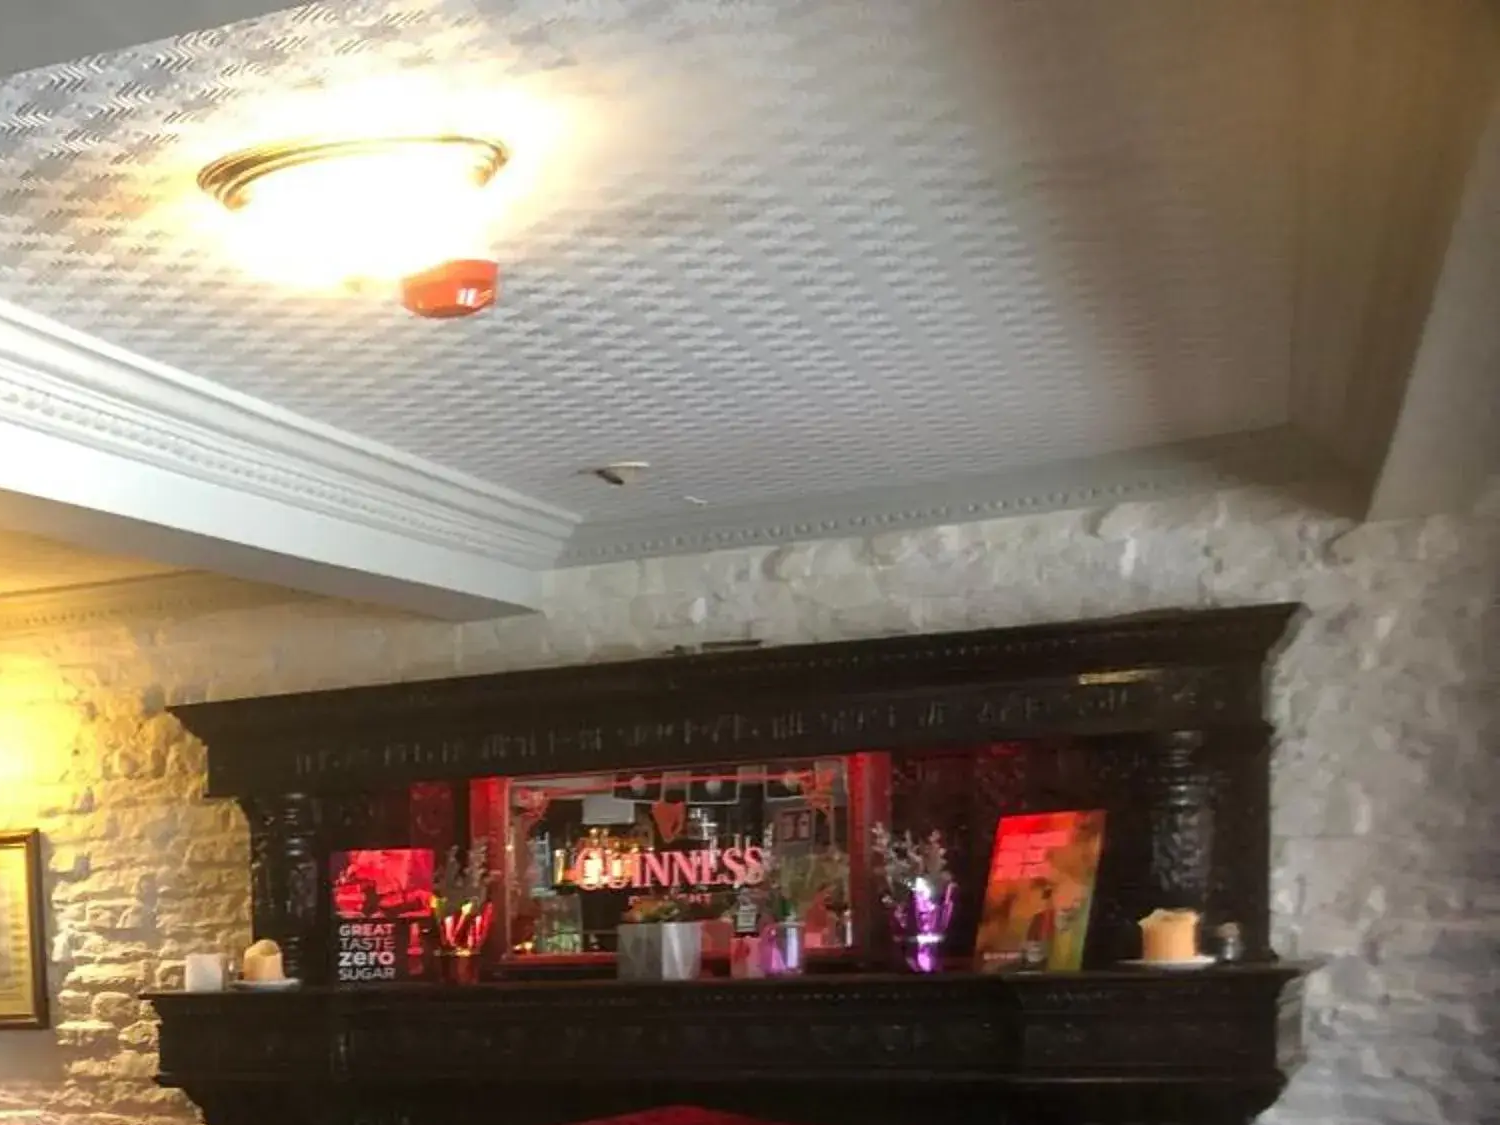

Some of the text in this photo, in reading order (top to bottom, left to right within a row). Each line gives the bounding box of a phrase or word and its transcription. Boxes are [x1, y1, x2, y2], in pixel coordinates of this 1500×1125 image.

[574, 846, 765, 890] GUINNESS
[339, 923, 396, 937] GREAT
[339, 937, 396, 950] TASTE
[338, 951, 396, 967] zero
[338, 967, 396, 981] SUGAR
